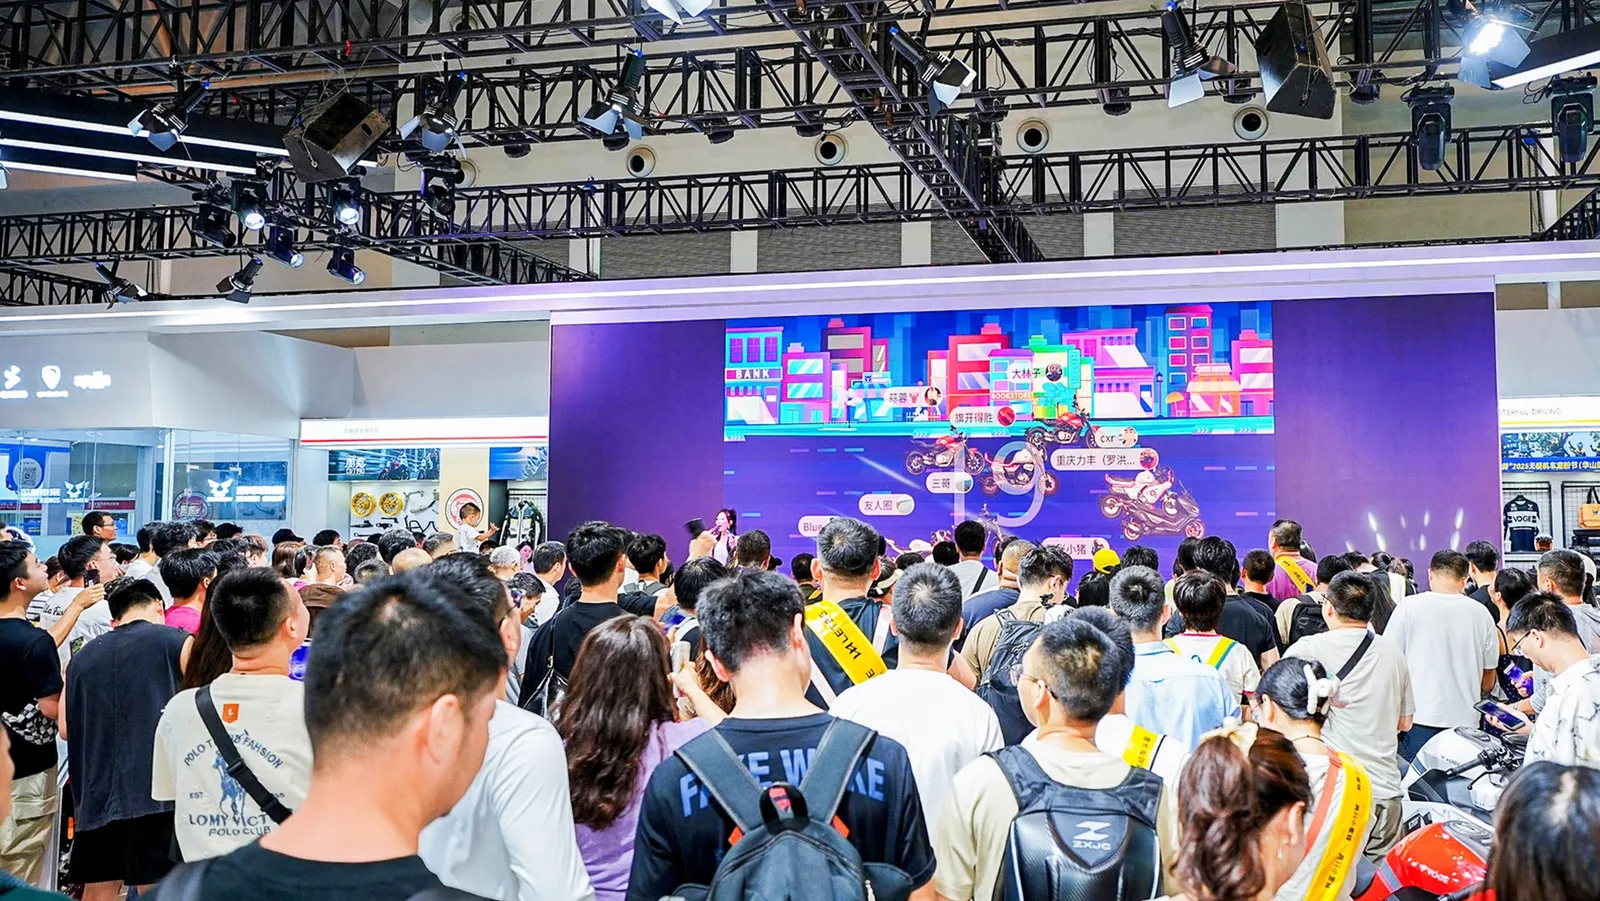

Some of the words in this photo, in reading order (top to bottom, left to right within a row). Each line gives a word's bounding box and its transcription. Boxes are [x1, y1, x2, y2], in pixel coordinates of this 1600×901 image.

[735, 369, 770, 379] BANK
[1012, 368, 1041, 379] 大林子
[991, 392, 1033, 400] BOOKSTORE
[955, 412, 993, 424] 旗开得胜
[932, 478, 951, 489] 三哥
[864, 500, 893, 511] 友人圈
[184, 743, 206, 766] POLO
[243, 737, 283, 768] FAHSION
[189, 814, 228, 826] LOMY
[233, 814, 267, 827] VICT
[209, 828, 240, 836] POLO
[243, 826, 271, 835] CLUB
[1427, 868, 1450, 884] VOGE
